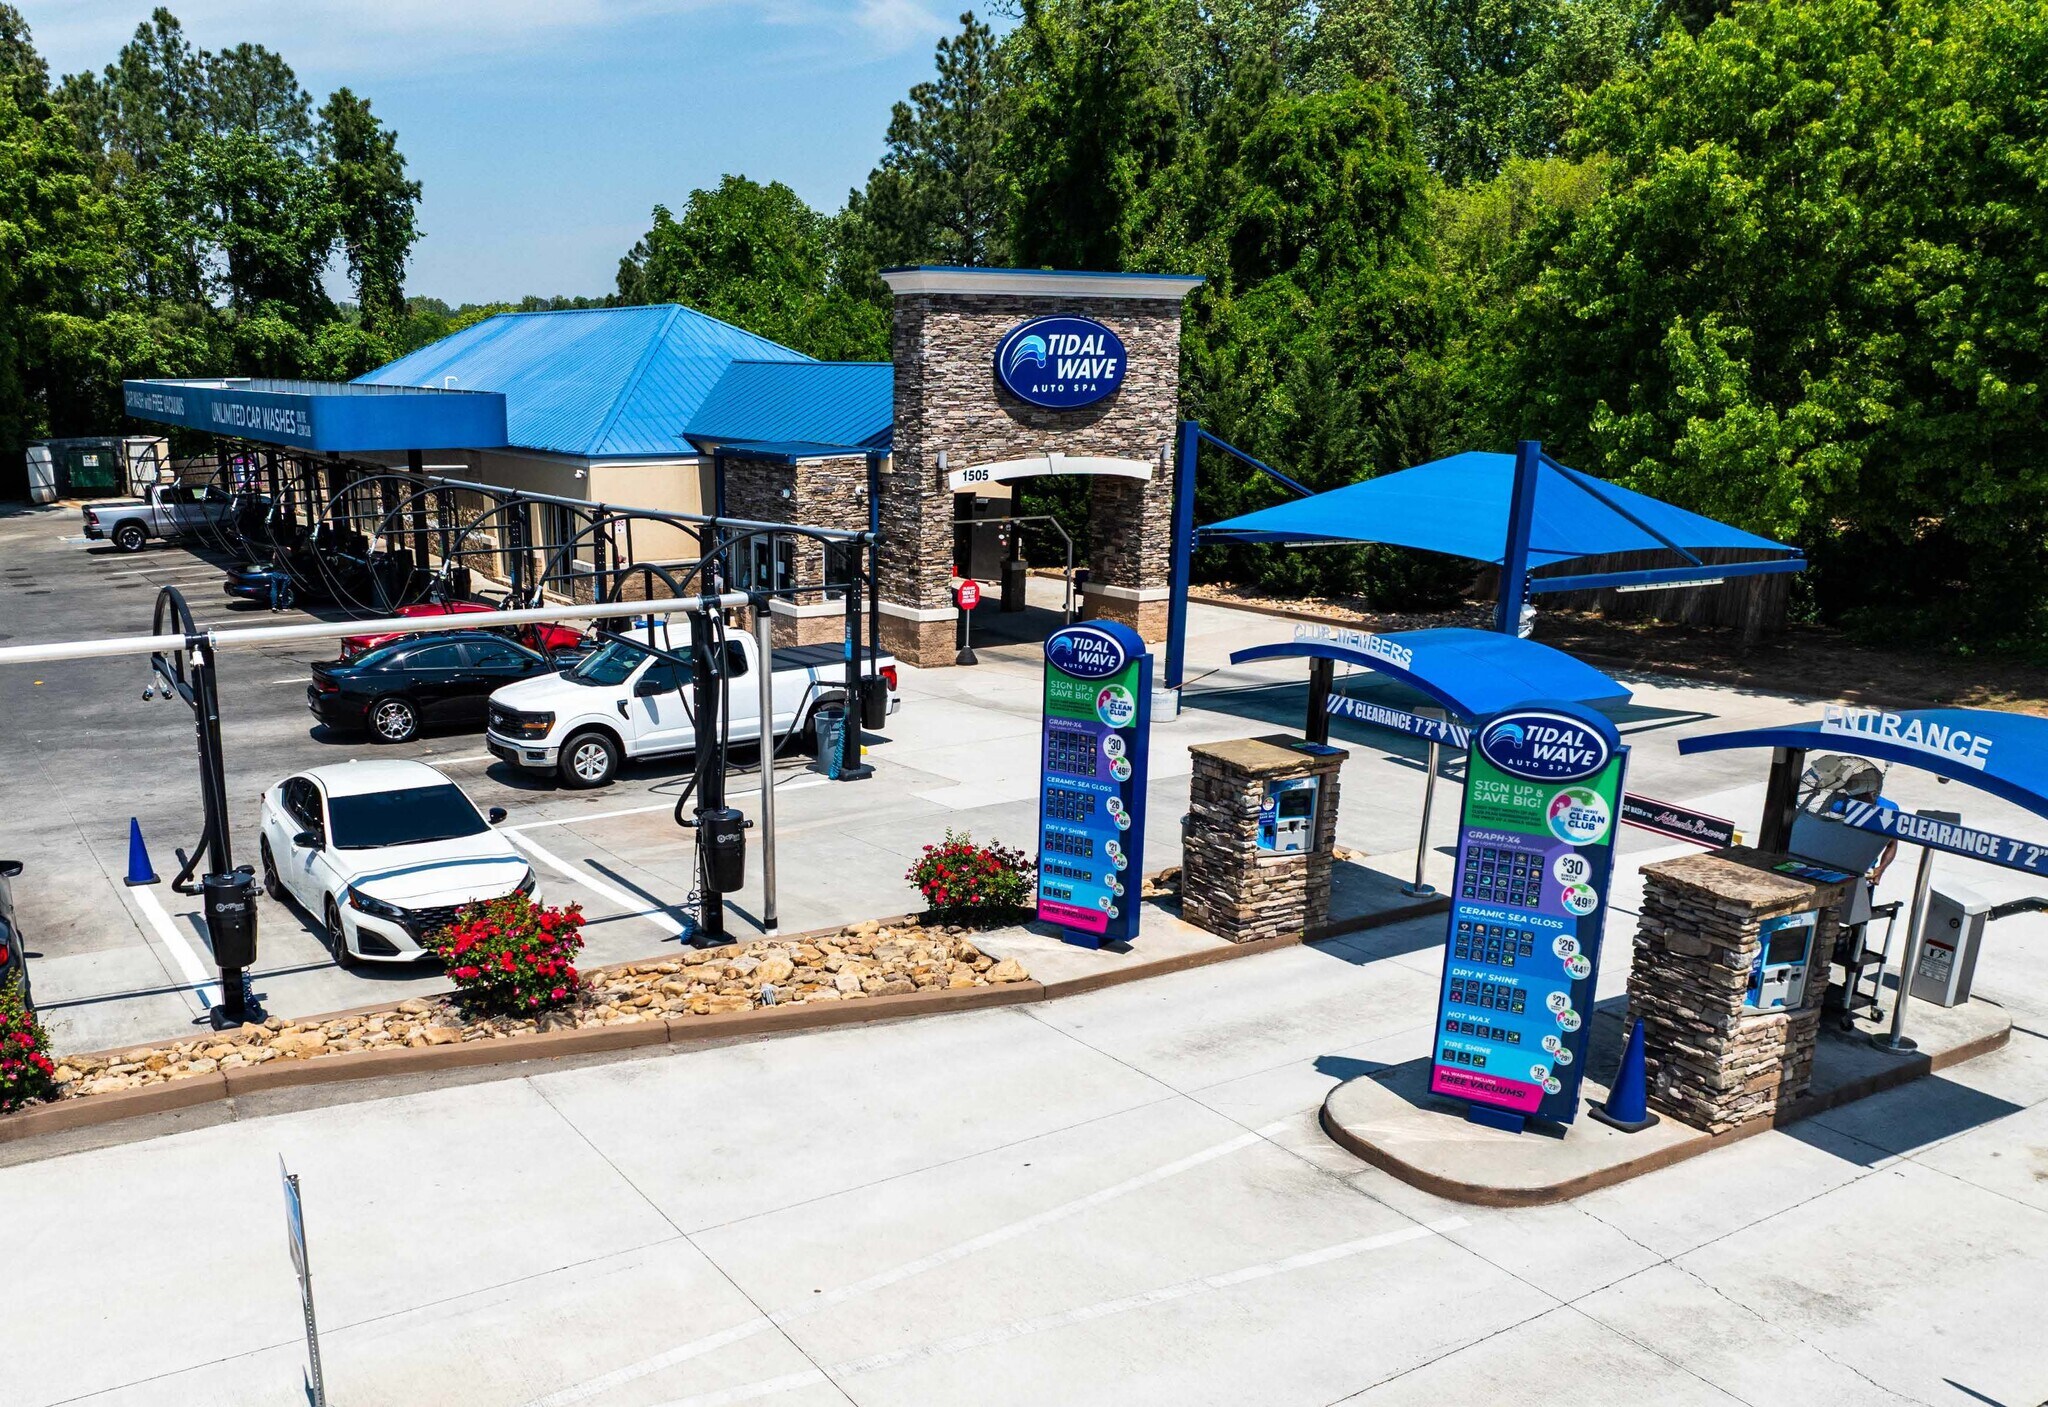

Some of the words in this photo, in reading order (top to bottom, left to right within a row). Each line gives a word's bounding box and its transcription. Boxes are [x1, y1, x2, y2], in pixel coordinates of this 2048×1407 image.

[1047, 333, 1106, 356] TIDAL
[1056, 357, 1118, 380] WAVE
[1032, 383, 1065, 394] AUTO
[1073, 382, 1097, 392] SPA
[152, 394, 163, 412] FREE
[212, 402, 246, 427] UNLIMITED
[246, 406, 262, 430] CAR
[262, 407, 296, 434] WASHES
[962, 468, 989, 482] 1505
[1073, 637, 1110, 654] TIDAL
[1294, 624, 1331, 641] CLUB
[1337, 628, 1413, 665] MEMBERS
[1078, 652, 1117, 668] WAVE
[1051, 680, 1072, 690] SIGN
[1075, 683, 1087, 692] UP
[1051, 689, 1073, 698] SAVE
[1076, 692, 1093, 700] BIG!
[1110, 702, 1132, 711] CLEAN
[1048, 719, 1082, 728] GRAPH-X4
[1355, 701, 1412, 731] CLEARANCE
[1525, 725, 1585, 746] TIDAL
[1822, 706, 1993, 760] ENTRANCE
[1108, 737, 1121, 750] $30
[1532, 745, 1596, 766] WAVE
[1508, 758, 1539, 768] AUTO
[1549, 764, 1572, 773] SPA
[1047, 777, 1077, 787] CERAMIC
[1078, 780, 1090, 789] SEA
[1092, 783, 1112, 793] GLOSS
[1475, 780, 1509, 793] SIGN
[1513, 785, 1533, 796] UP
[1536, 789, 1544, 798] &
[1110, 799, 1120, 809] $26
[1474, 790, 1509, 804] SAVE
[1513, 795, 1541, 808] BIG!
[1569, 812, 1605, 824] CLEAN
[1631, 806, 1643, 816] WASH
[1568, 821, 1596, 830] CLUB
[1654, 811, 1694, 830] Atlanta
[1069, 828, 1088, 836] SHINE
[1468, 831, 1521, 844] GRAPH-X4
[1896, 812, 2000, 858] CLEARANCE
[2007, 841, 2024, 862] 7'
[1563, 858, 1583, 876] $30
[1057, 882, 1074, 890] SHINE
[1573, 895, 1588, 908] $49
[1459, 906, 1505, 919] CERAMIC
[1508, 913, 1527, 923] SEA
[1530, 917, 1564, 929] GLOSS
[1559, 938, 1574, 952] $26
[1452, 968, 1474, 979] DRY
[1475, 971, 1487, 980] N'
[1488, 973, 1519, 986] SHINE
[1553, 994, 1566, 1007] $21
[1447, 1010, 1467, 1019] HOT
[1468, 1014, 1490, 1024] WAX
[1444, 1040, 1463, 1049] TIRE
[1465, 1043, 1492, 1055] SHINE
[1546, 1037, 1556, 1046] $17
[1451, 1072, 1474, 1080] WASHES
[1474, 1076, 1497, 1084] INCLUDE
[1534, 1066, 1544, 1076] $12
[1440, 1074, 1467, 1085] FREE
[1470, 1080, 1526, 1098] VACUUMS!
